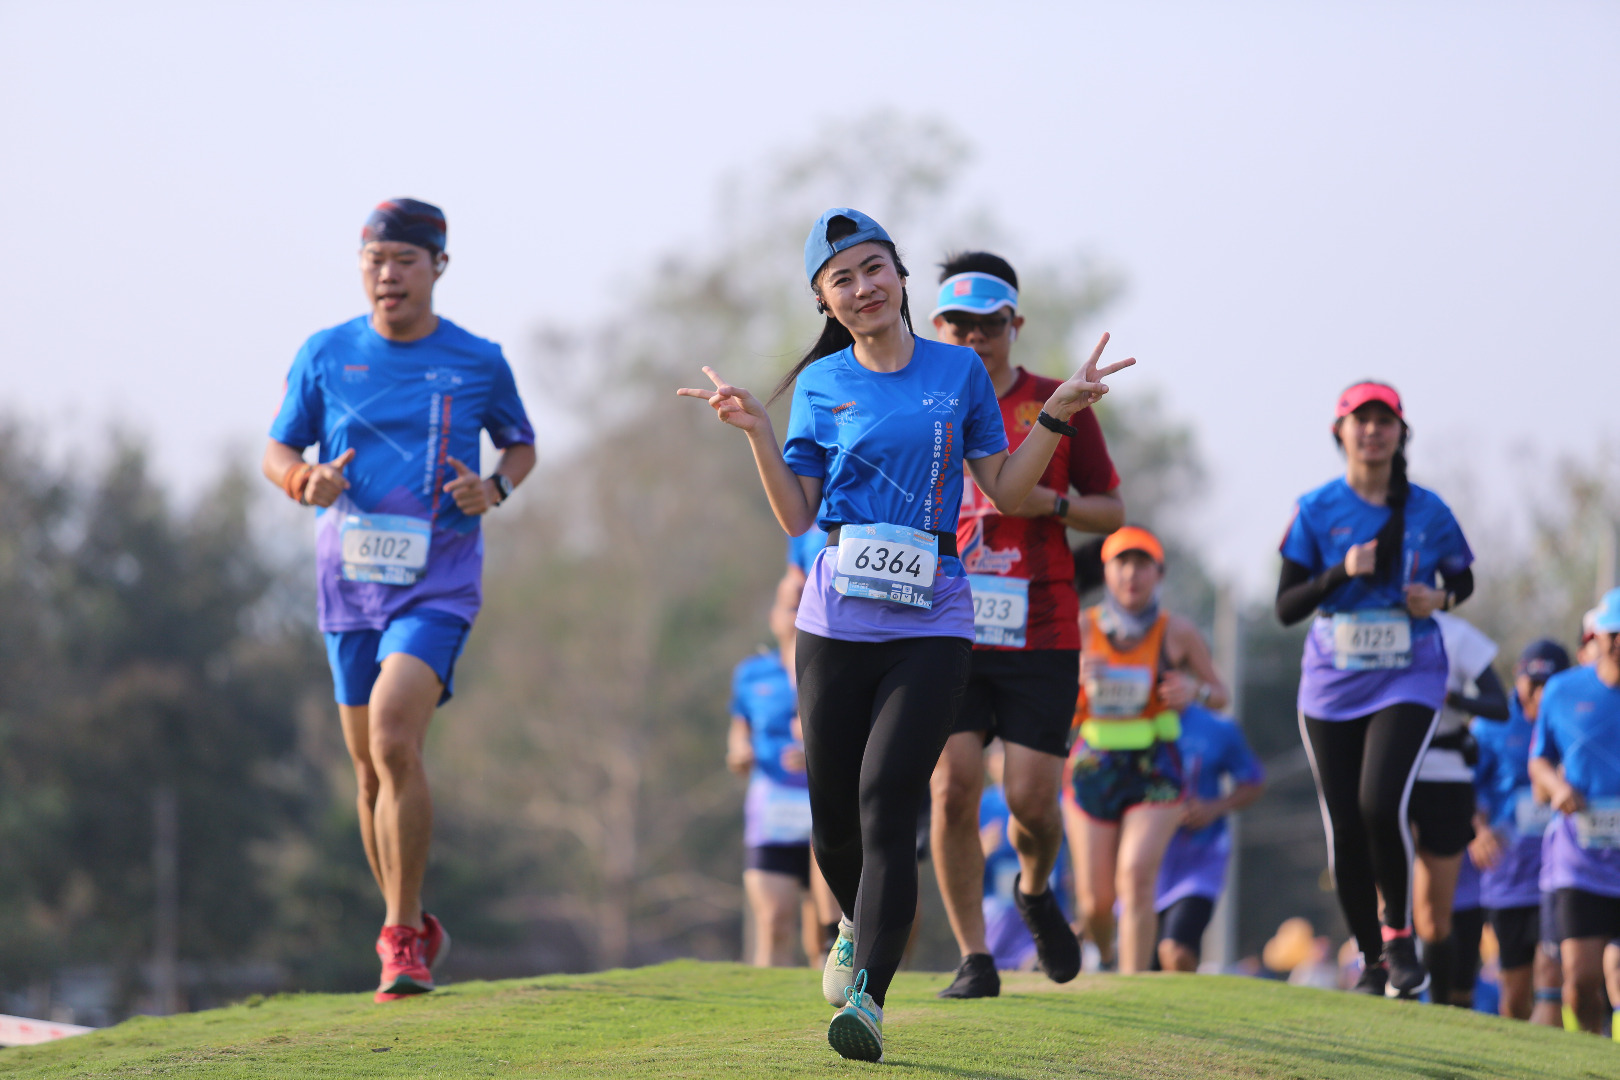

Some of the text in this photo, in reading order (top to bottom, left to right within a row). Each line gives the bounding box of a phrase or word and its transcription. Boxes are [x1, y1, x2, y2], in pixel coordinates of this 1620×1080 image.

[922, 398, 934, 406] SP
[934, 421, 943, 458] CROSS
[942, 421, 953, 470] SINGHA
[924, 461, 939, 514] COUTRY
[936, 473, 945, 505] PARK
[358, 535, 411, 560] 6102
[855, 546, 921, 578] 6364
[913, 592, 925, 606] 16
[1351, 627, 1396, 648] 6125
